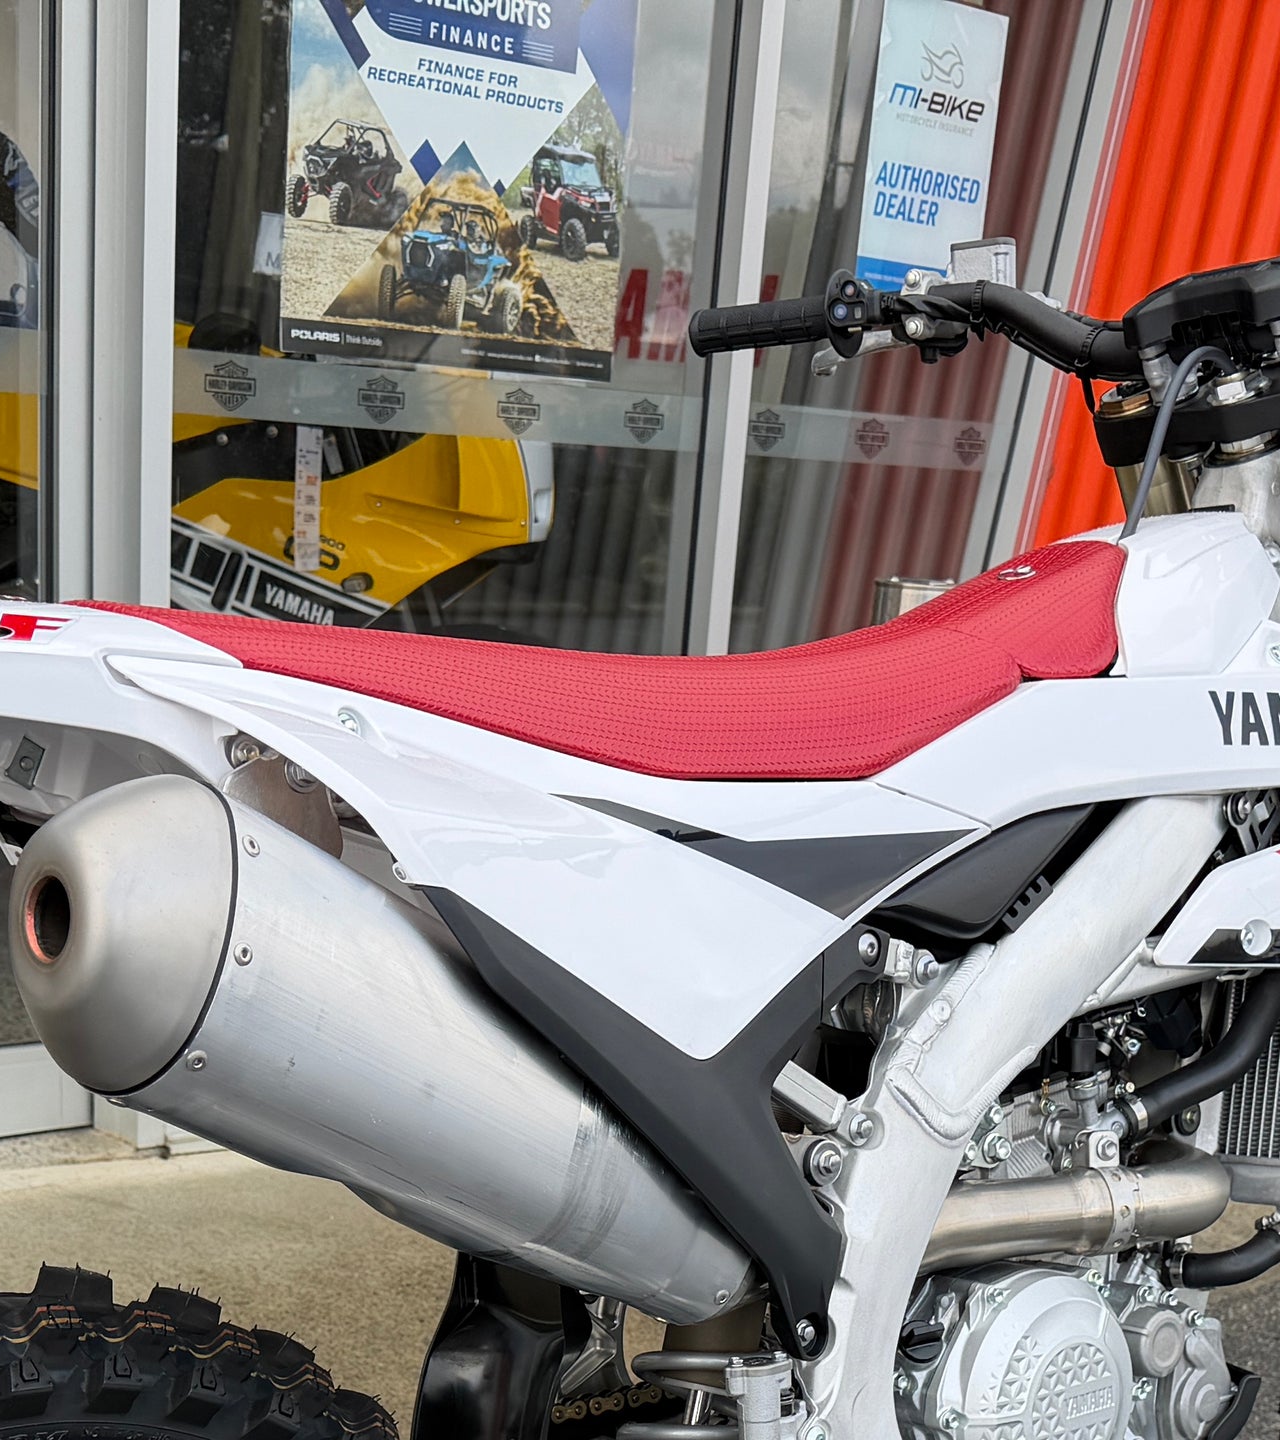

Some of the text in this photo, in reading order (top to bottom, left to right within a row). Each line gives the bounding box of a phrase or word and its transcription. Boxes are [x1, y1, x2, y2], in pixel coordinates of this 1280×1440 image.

[428, 21, 515, 55] FINANCE
[367, 66, 565, 114] RECREATIONAL PRODUCTS
[417, 57, 519, 88] FINANCE FOR
[875, 160, 981, 205] AUTHORISED
[873, 191, 939, 227] DEALER
[291, 328, 340, 343] POLARIS
[264, 582, 335, 627] YAMAHA
[1063, 1384, 1116, 1420] YAMAHA
